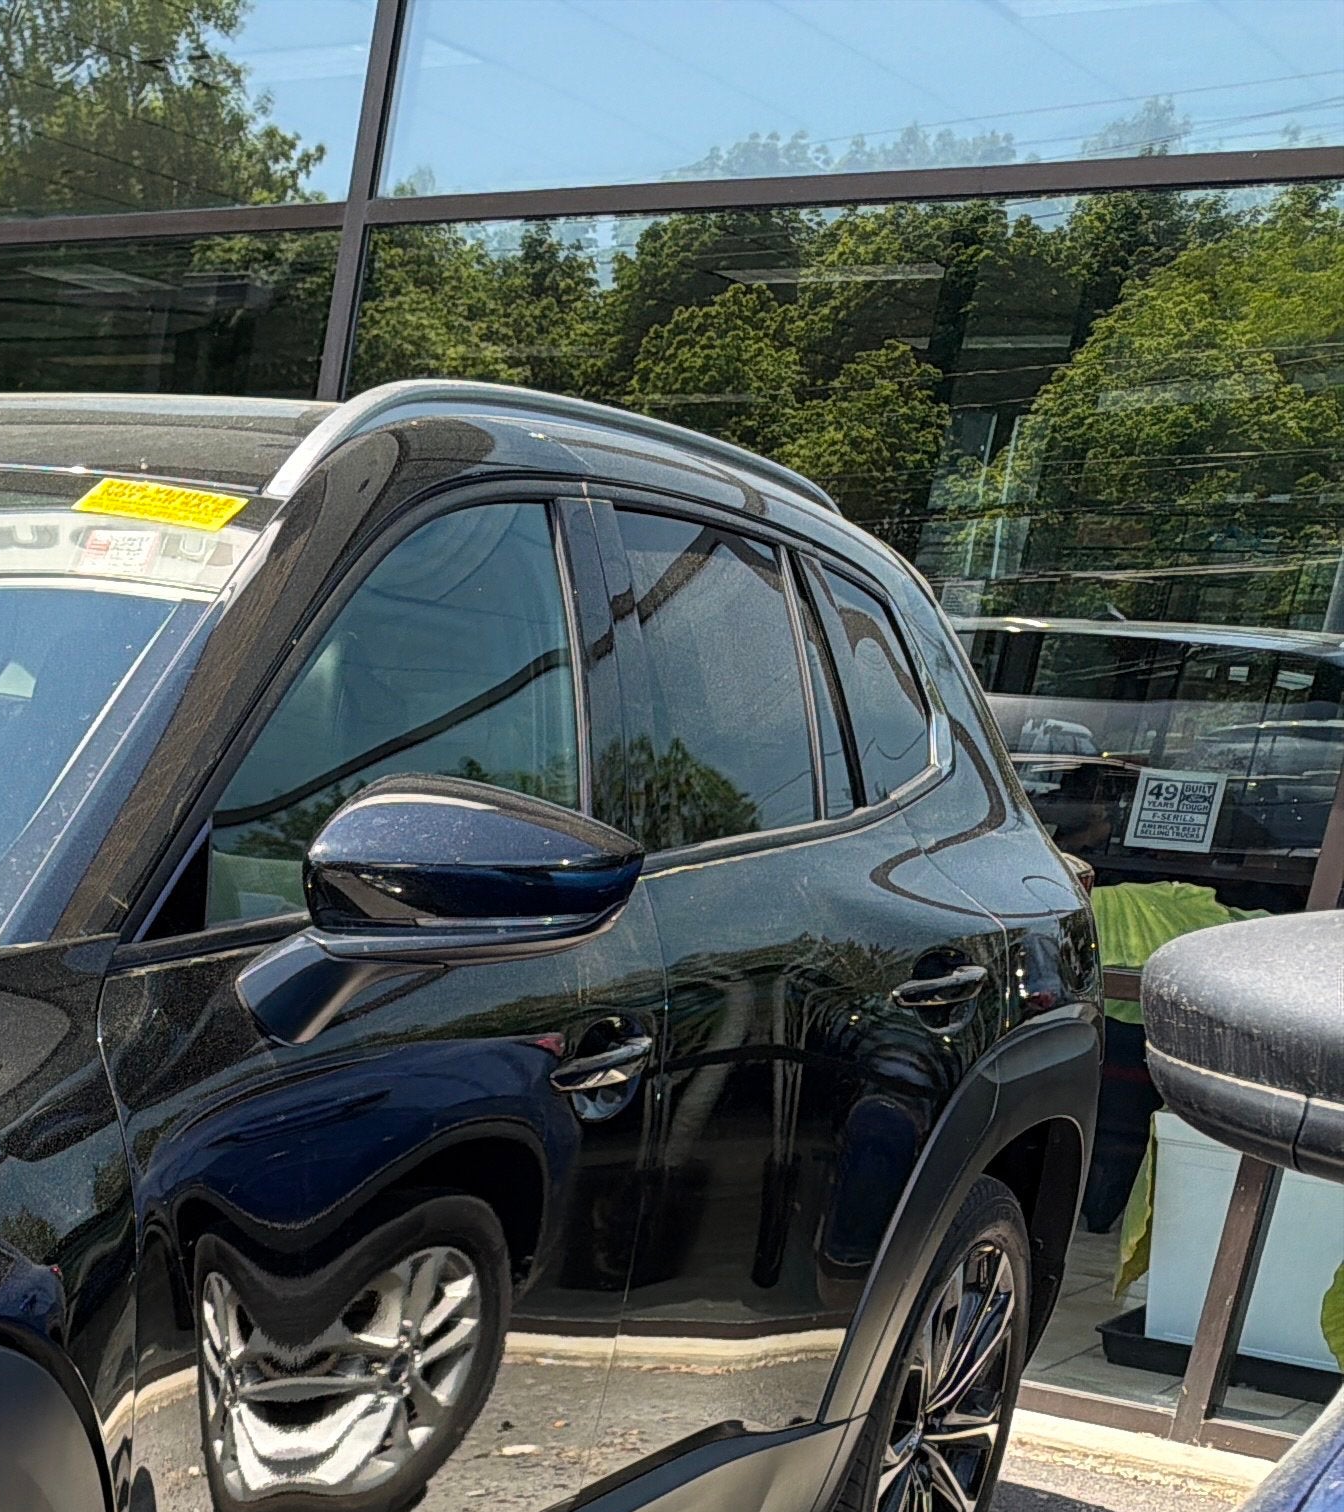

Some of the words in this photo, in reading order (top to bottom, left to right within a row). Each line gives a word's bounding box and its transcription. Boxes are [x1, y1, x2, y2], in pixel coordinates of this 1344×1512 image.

[106, 480, 149, 493] THIS
[155, 487, 238, 509] VEHICLE
[101, 489, 138, 500] NOT
[139, 494, 176, 506] FOR
[180, 501, 227, 515] SALE
[1148, 783, 1180, 801] 49
[1184, 784, 1215, 795] BUILT
[1147, 800, 1175, 809] YEARS
[1181, 802, 1210, 812] TOUGH
[1151, 812, 1196, 823] F-SERIES
[1140, 829, 1170, 837] SELLING
[1171, 831, 1200, 839] TRUCKS
[1141, 823, 1180, 832] AMERICA'S
[1181, 826, 1201, 834] BEST
